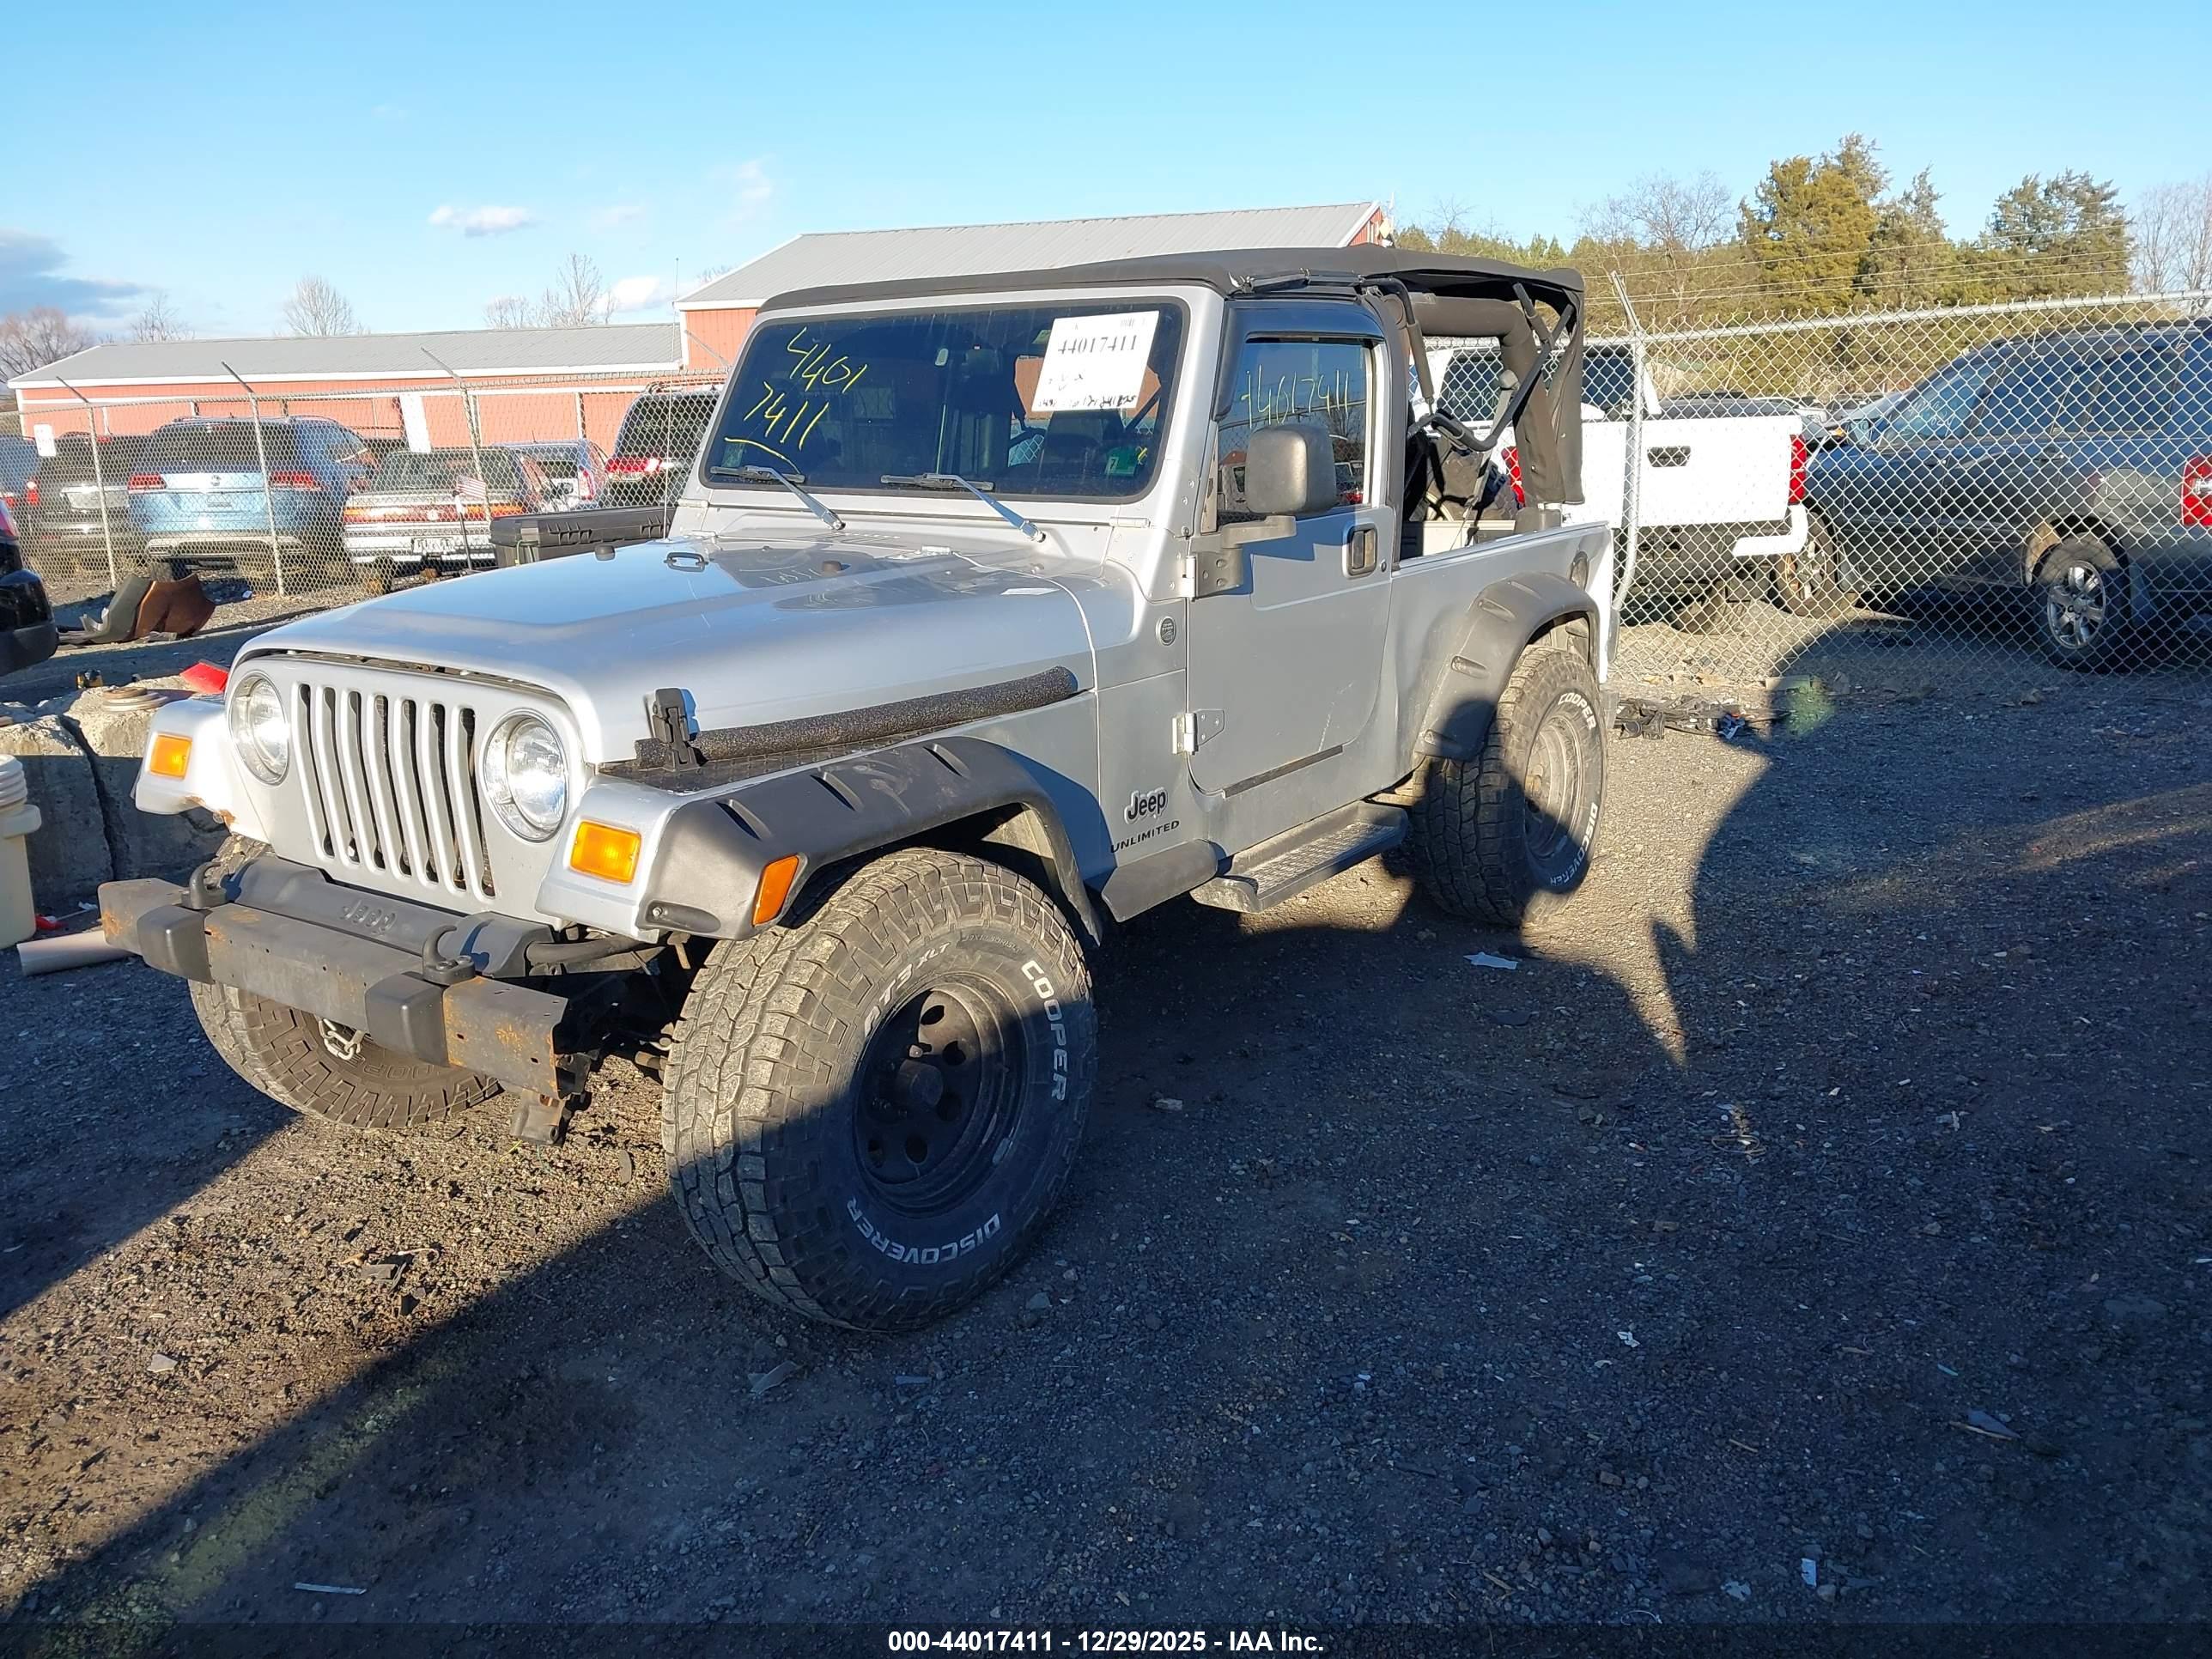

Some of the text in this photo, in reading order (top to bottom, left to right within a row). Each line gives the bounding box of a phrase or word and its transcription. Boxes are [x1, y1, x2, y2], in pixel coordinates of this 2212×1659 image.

[787, 326, 868, 394] 4401
[1057, 334, 1138, 355] 44017411
[743, 380, 830, 452] 7411
[1557, 691, 1597, 731] COOPER
[1126, 789, 1167, 822] Jeep
[1110, 819, 1181, 854] UNLIMITED
[1549, 801, 1599, 885] DISCOVERER
[340, 899, 398, 937] Jeep
[1021, 959, 1068, 1102] COOPER
[847, 1195, 1001, 1266] DISCOVERER
